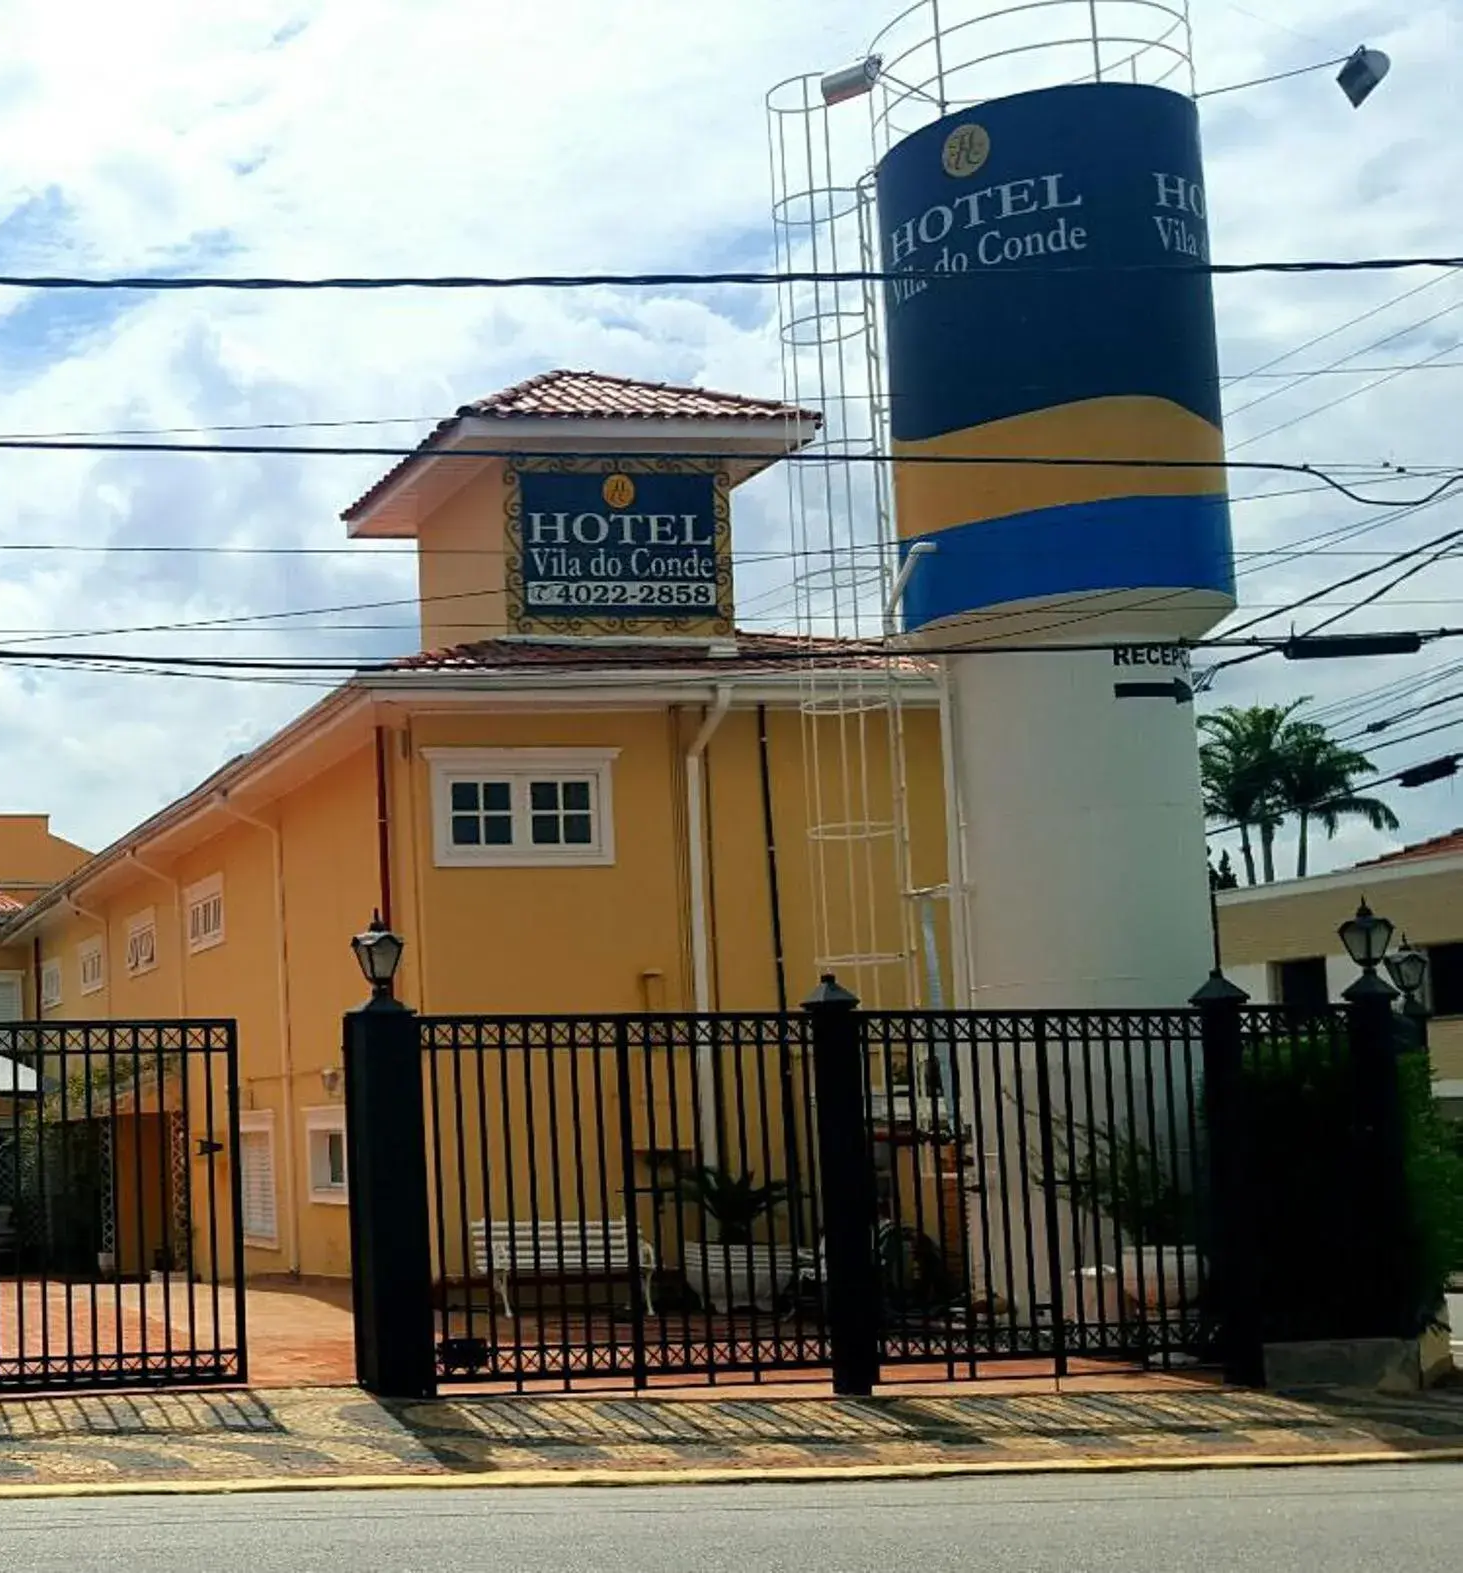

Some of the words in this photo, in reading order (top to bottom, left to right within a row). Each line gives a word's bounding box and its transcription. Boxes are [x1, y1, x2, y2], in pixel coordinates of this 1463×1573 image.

[889, 172, 1083, 266] HOTEL
[1151, 215, 1200, 257] Vila
[934, 247, 969, 275] do
[977, 217, 1088, 265] Conde
[527, 512, 713, 546] HOTEL
[529, 547, 583, 578] Vila
[589, 547, 622, 577] do
[630, 547, 715, 578] Conde
[555, 583, 712, 605] 4022-2858
